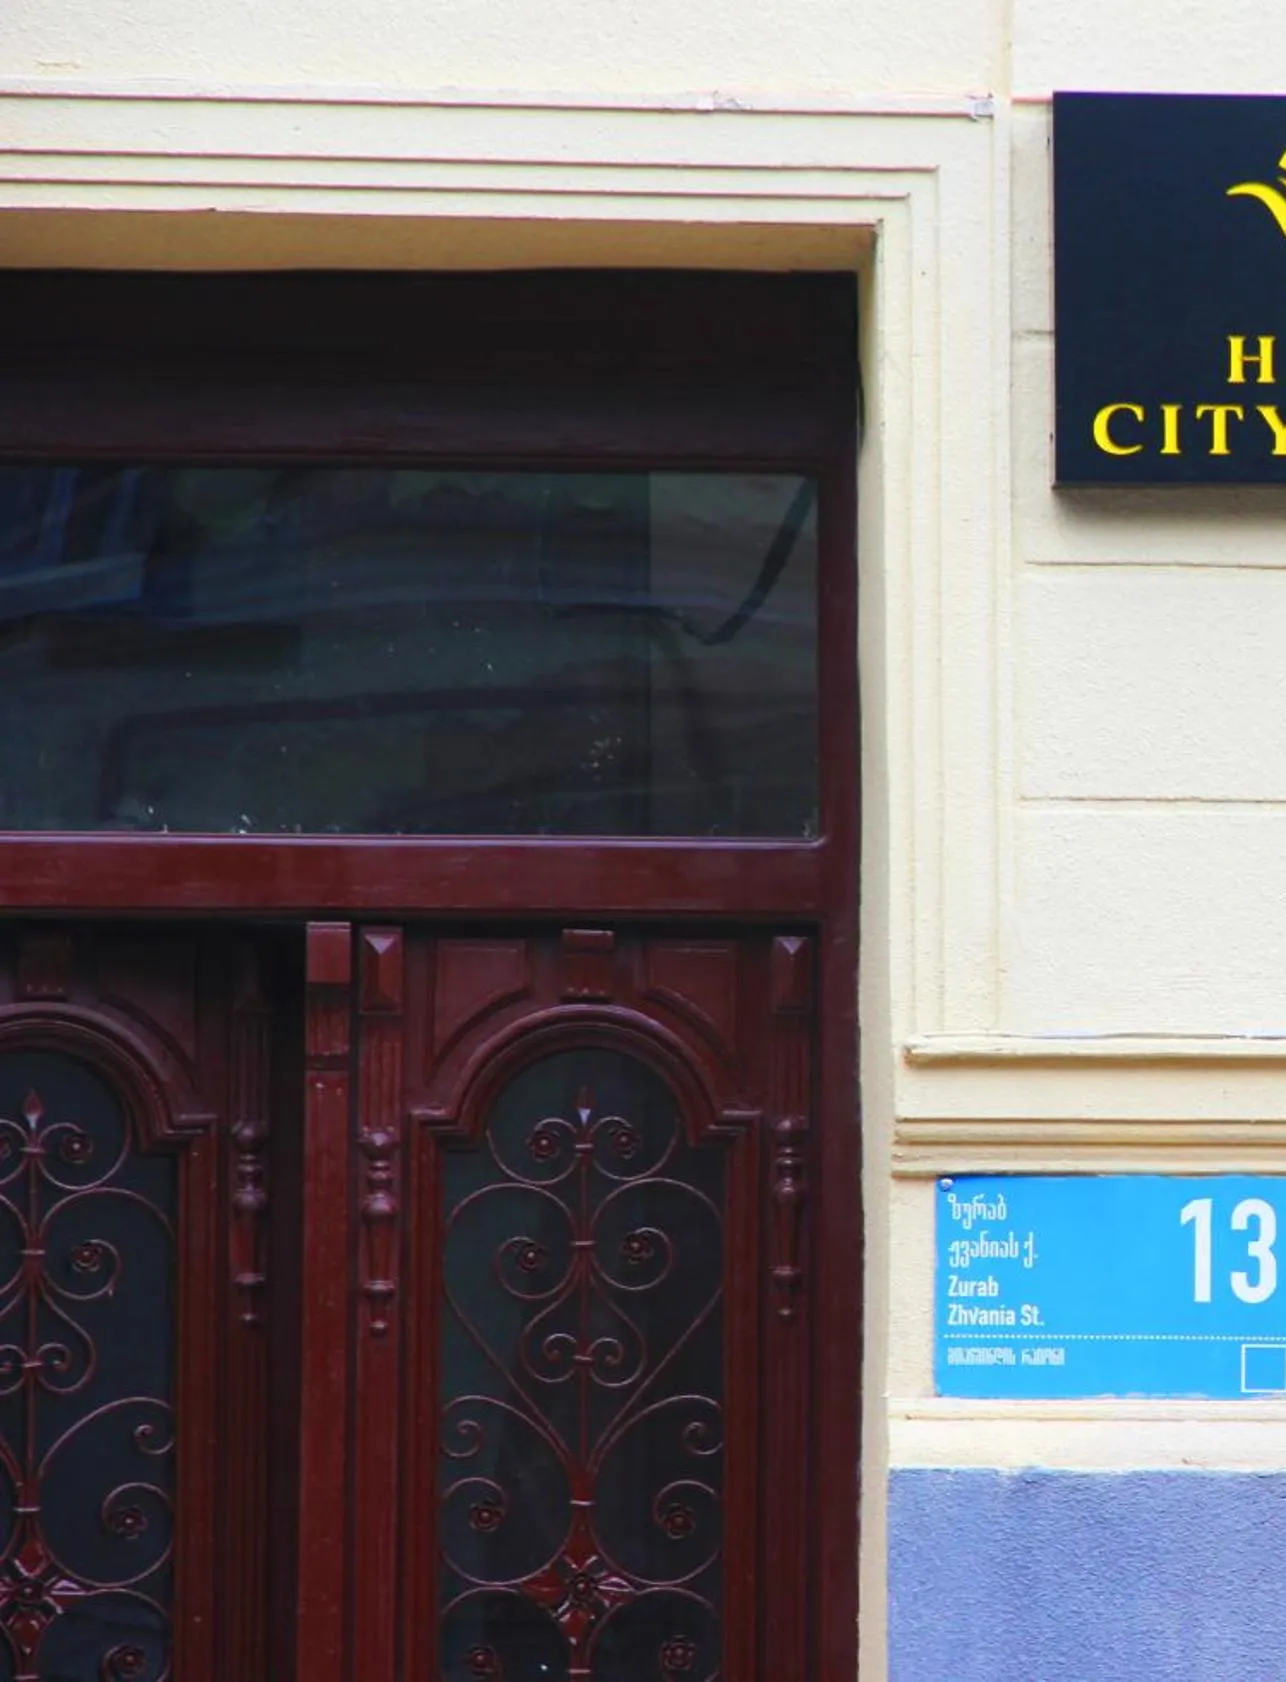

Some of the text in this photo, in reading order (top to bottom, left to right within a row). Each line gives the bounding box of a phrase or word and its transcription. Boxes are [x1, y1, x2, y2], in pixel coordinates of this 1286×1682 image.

[947, 1193, 1008, 1230] ზურაბ
[947, 1231, 1039, 1269] ჟვანიას ქ.
[1179, 1197, 1278, 1305] 13
[947, 1275, 999, 1298] Zurab
[947, 1303, 1045, 1327] Zhvania St.
